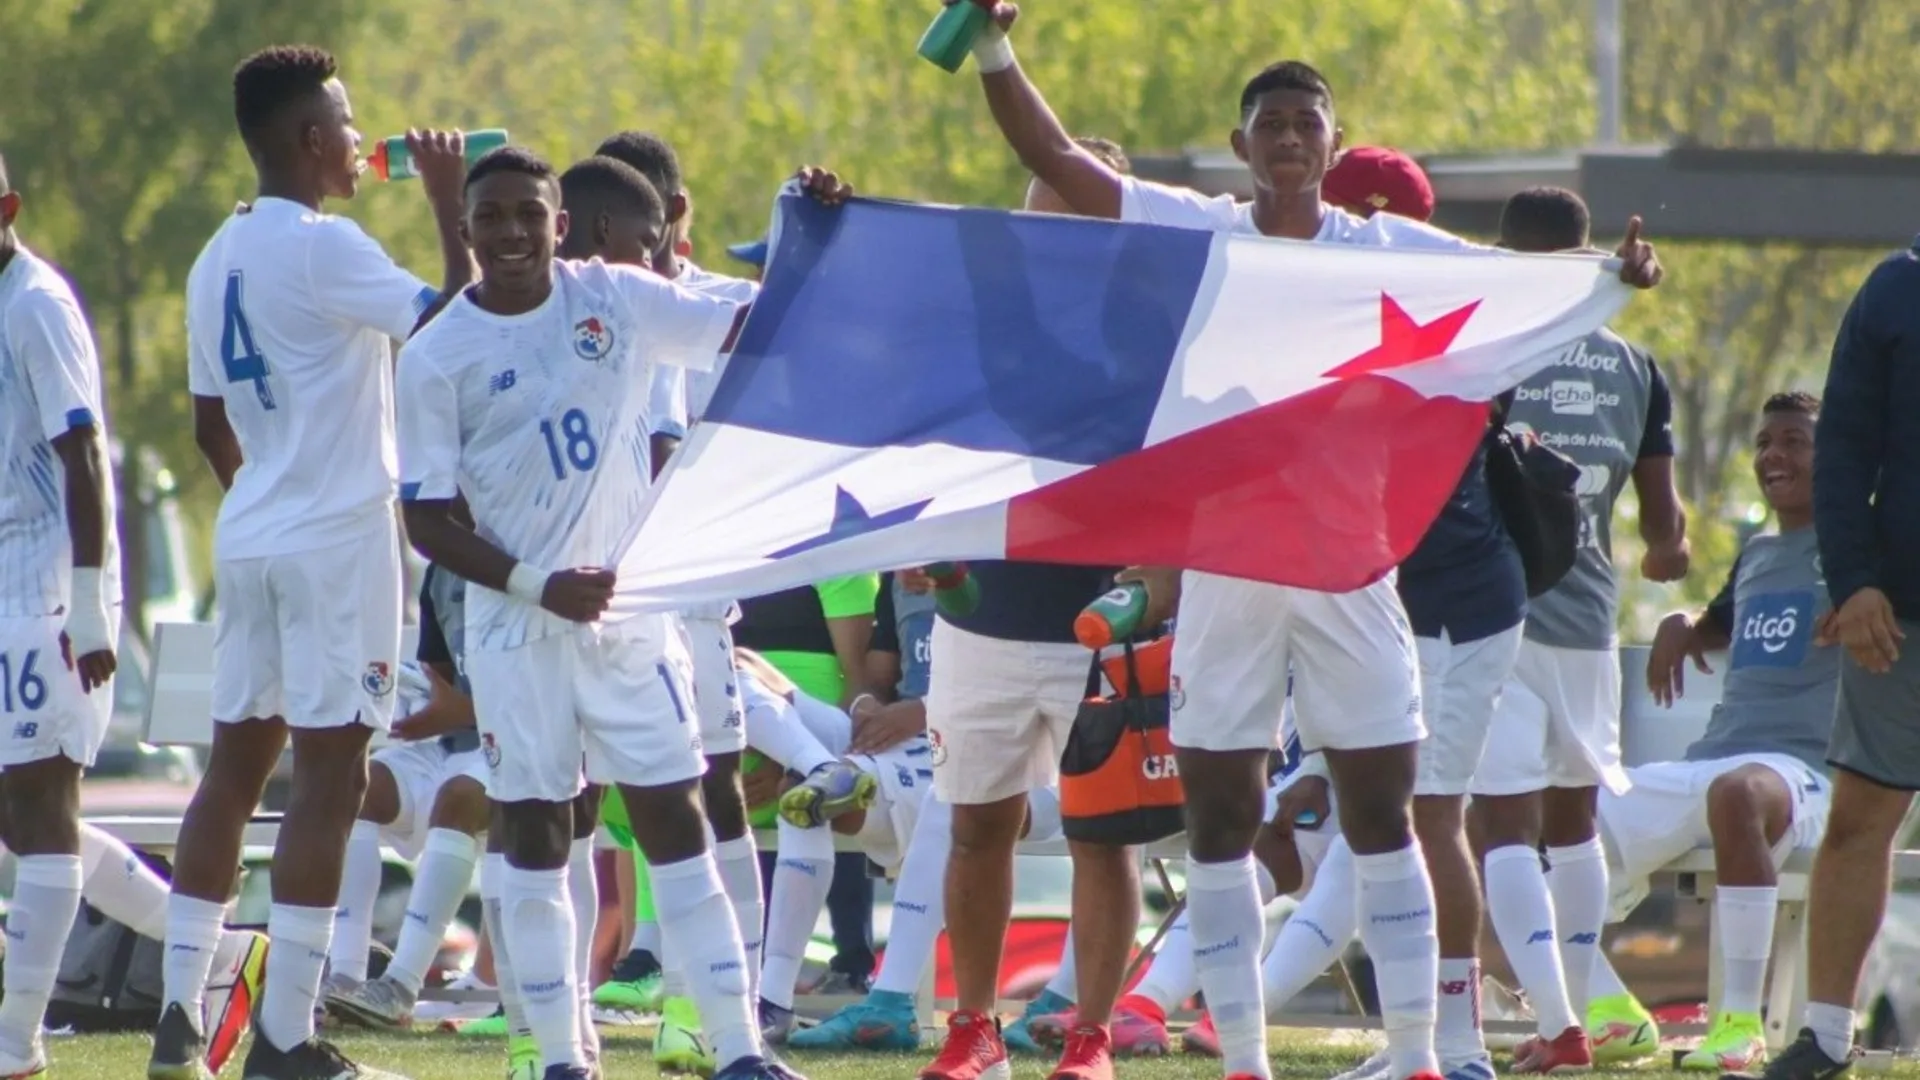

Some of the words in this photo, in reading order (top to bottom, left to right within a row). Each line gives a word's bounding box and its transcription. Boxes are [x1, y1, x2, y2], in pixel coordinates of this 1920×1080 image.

[221, 269, 277, 411] 4
[540, 408, 598, 481] 18
[1540, 431, 1569, 448] Caja
[1570, 433, 1587, 447] de
[0, 649, 48, 713] 16
